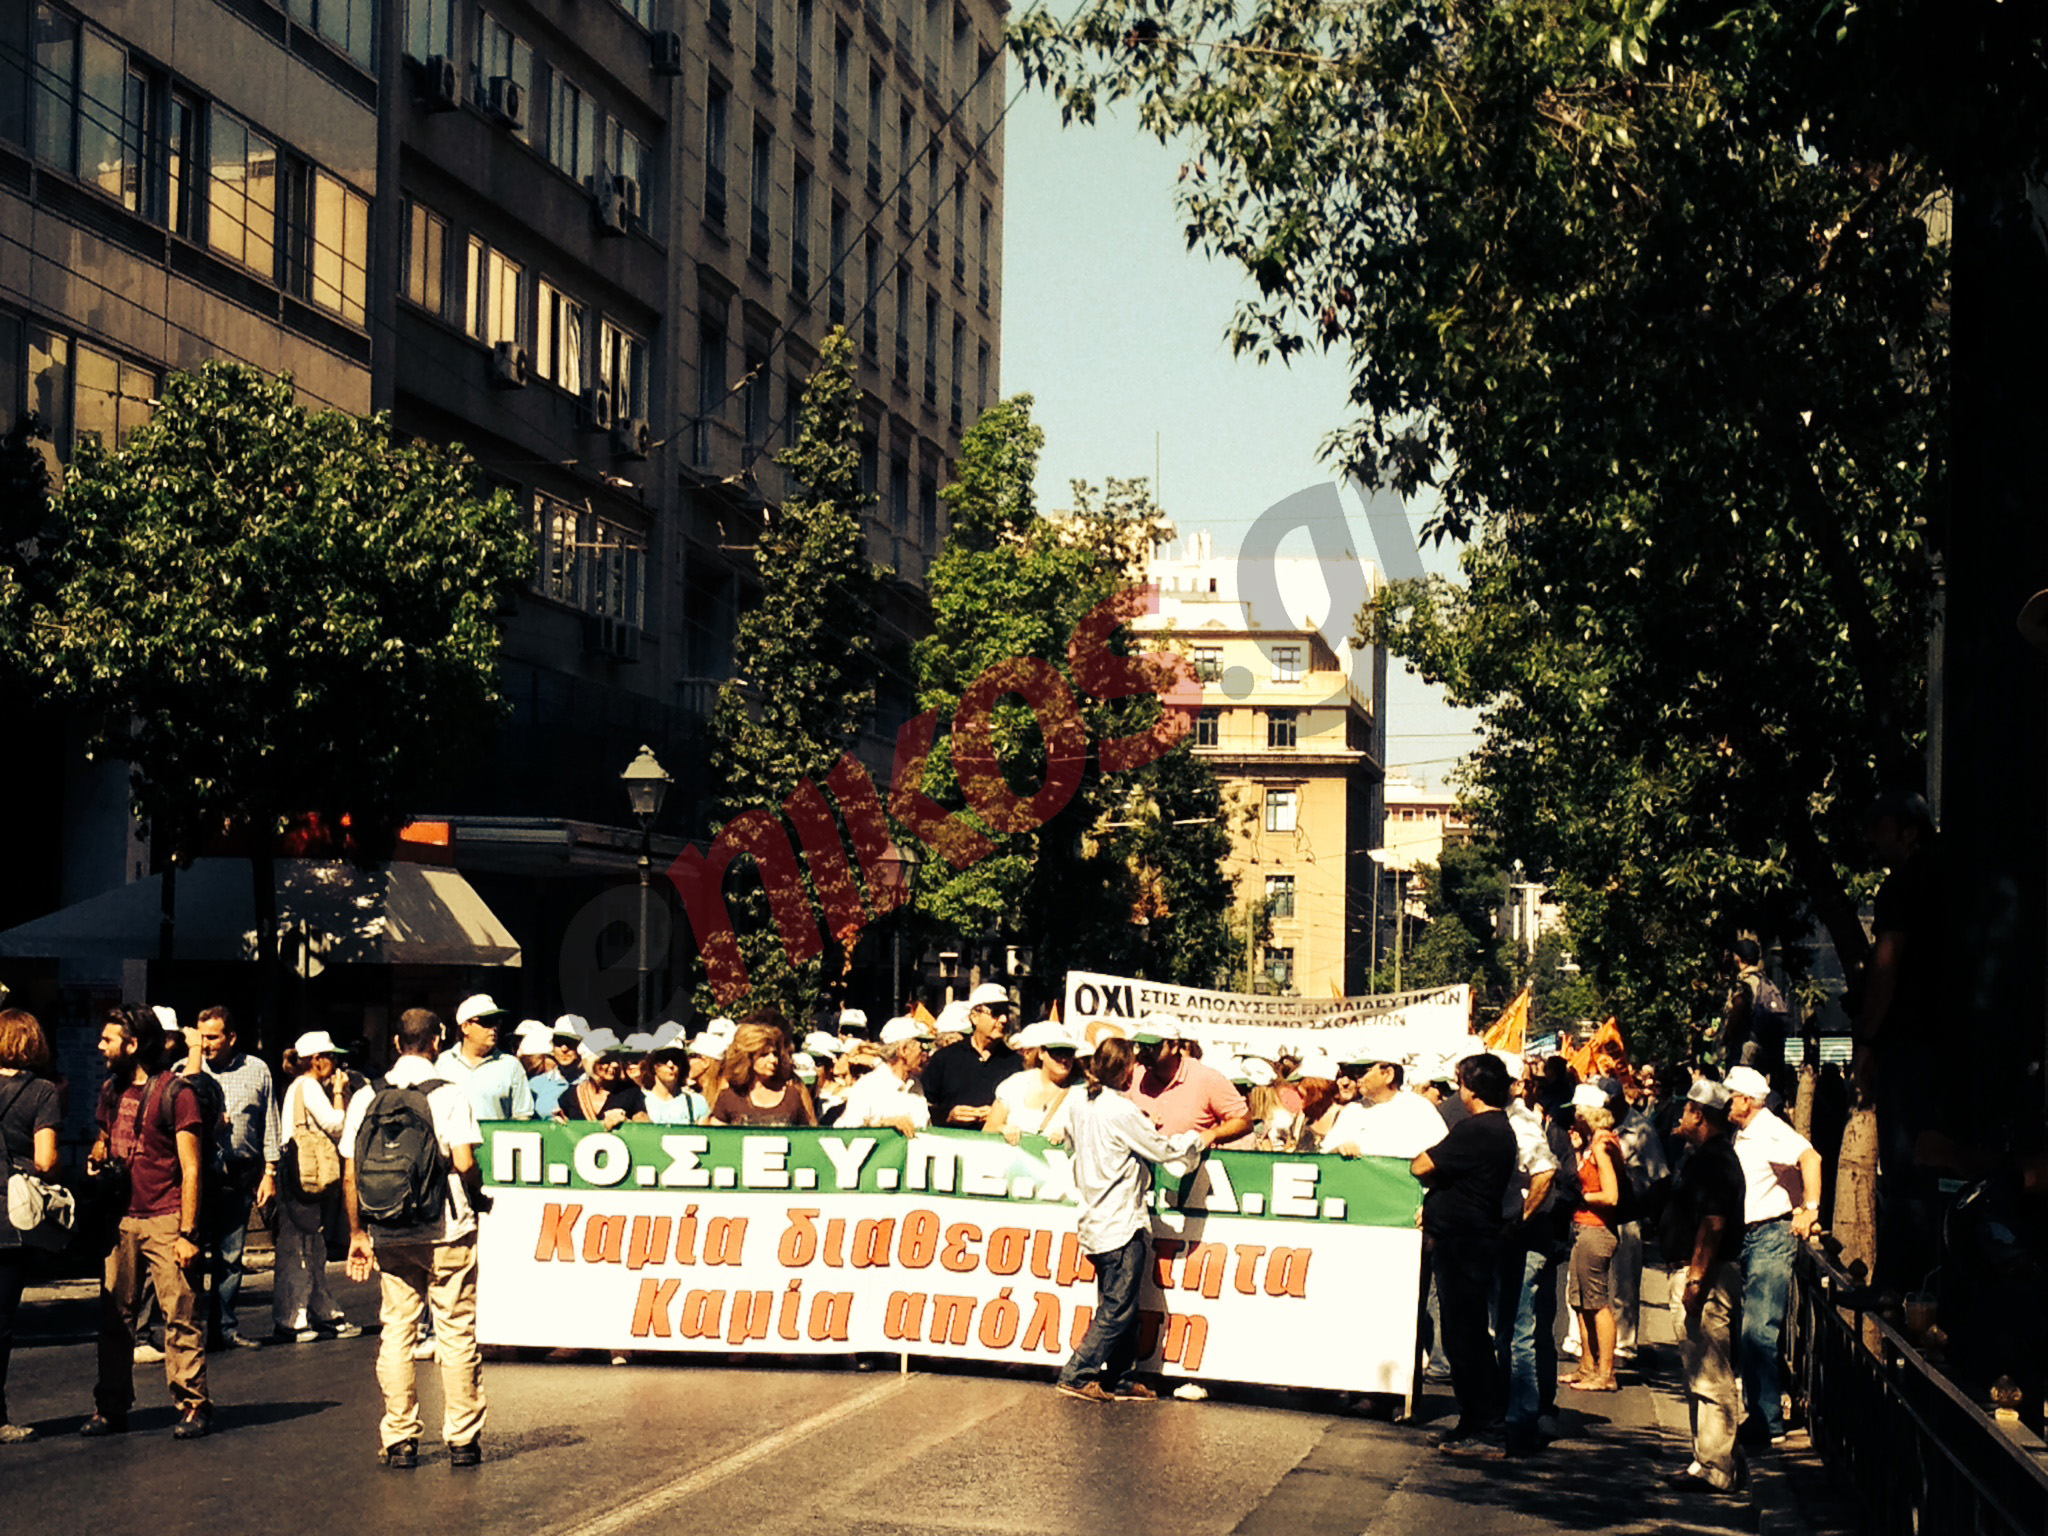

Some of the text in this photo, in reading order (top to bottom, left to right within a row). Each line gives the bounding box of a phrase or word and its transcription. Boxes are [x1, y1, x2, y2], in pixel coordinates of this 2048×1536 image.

[1074, 983, 1135, 1018] ΟΧΙ
[1140, 989, 1180, 1007] ΣΤΙΣ
[1187, 995, 1296, 1015] ΑΠΟΛΥΣΕΙΣ
[534, 1203, 1313, 1298] Καμία διαθεσιμτητα
[631, 1278, 855, 1345] Καμία
